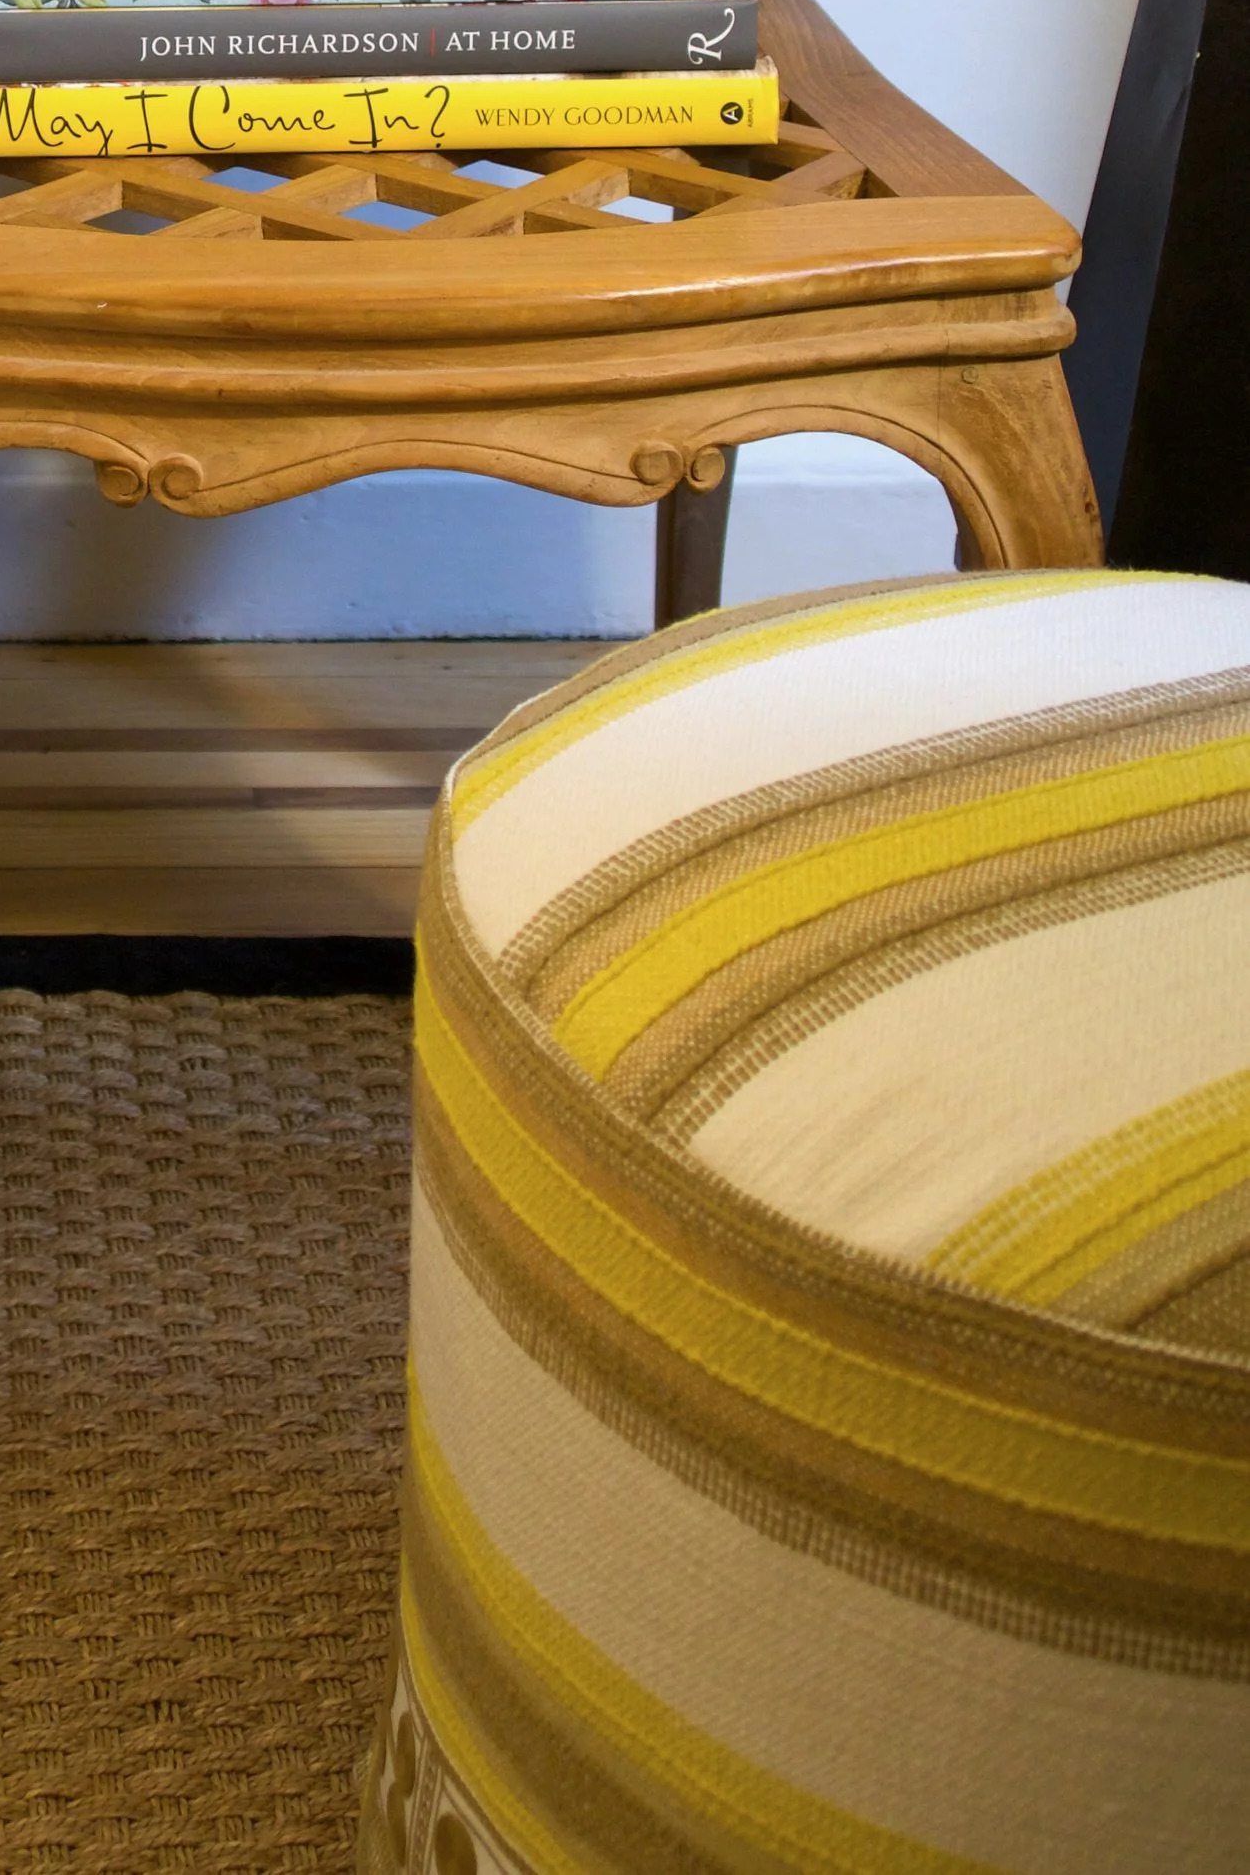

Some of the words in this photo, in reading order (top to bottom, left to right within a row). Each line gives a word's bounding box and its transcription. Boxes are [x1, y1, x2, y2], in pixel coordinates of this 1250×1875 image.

[139, 35, 216, 61] JOHN
[227, 32, 419, 57] RICHARDSON
[445, 31, 481, 52] AT
[490, 29, 576, 51] HOME
[686, 6, 736, 66] R
[124, 88, 168, 153] I
[188, 84, 336, 151] Come
[343, 84, 450, 149] In?
[474, 107, 556, 127] WENDY
[564, 105, 694, 126] GOODMAN
